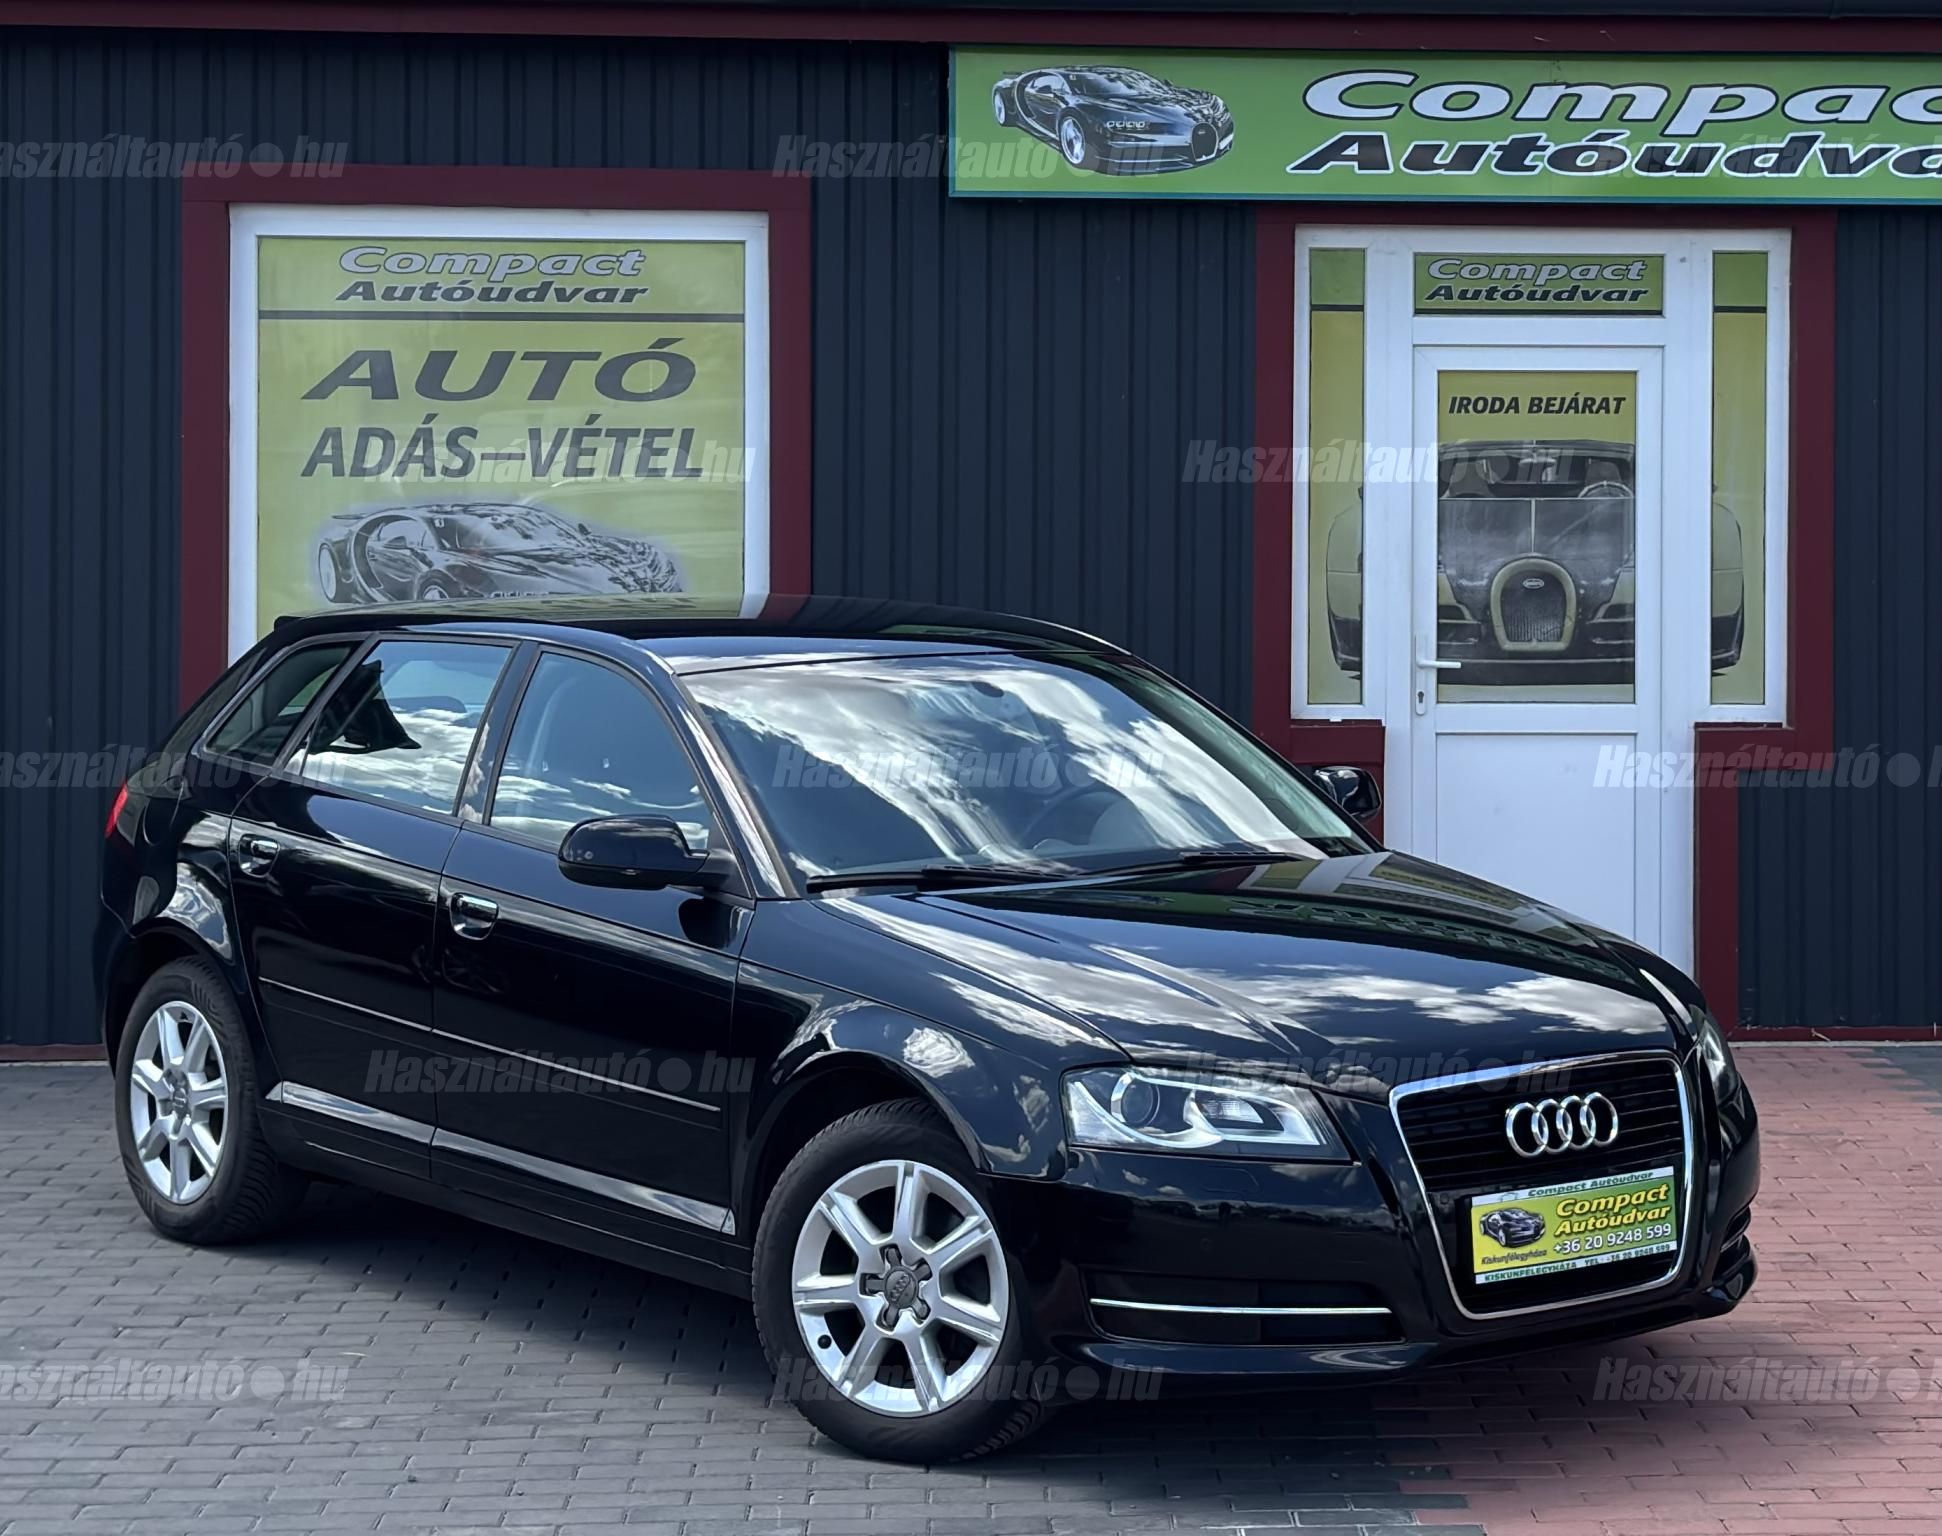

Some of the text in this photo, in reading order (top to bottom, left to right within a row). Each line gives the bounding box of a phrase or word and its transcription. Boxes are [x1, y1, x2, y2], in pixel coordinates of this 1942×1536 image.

[339, 246, 647, 283] Compact
[1427, 258, 1648, 287] Compact
[335, 280, 650, 303] Autóudvar
[1425, 284, 1649, 302] Autóudvar
[301, 337, 697, 402] AUTÓ
[1448, 391, 1627, 415] IRODA BEJÁRAT
[1527, 1180, 1587, 1197] Compact
[1556, 1182, 1669, 1218] Compact
[1554, 1204, 1671, 1236] Autóudvar
[1553, 1222, 1672, 1255] +36 20 9248 599
